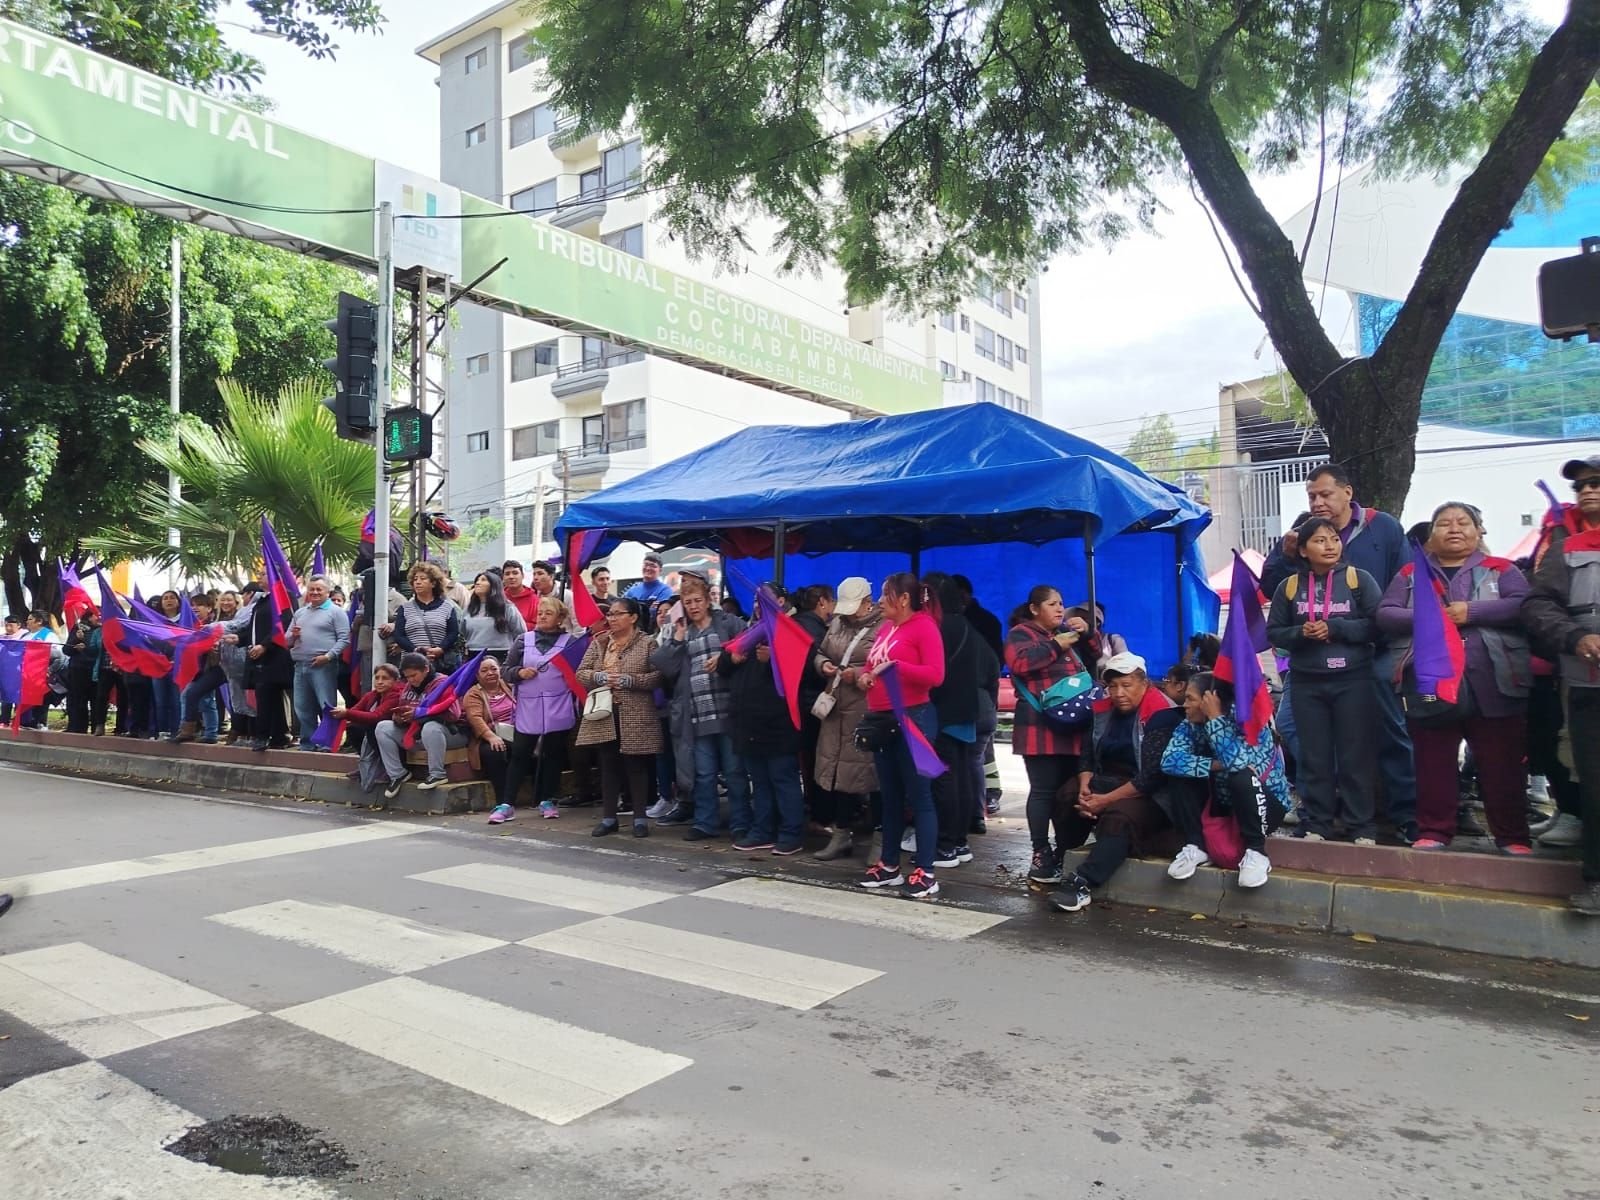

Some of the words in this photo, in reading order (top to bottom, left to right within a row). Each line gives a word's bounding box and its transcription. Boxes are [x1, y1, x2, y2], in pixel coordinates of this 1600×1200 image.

[400, 217, 438, 240] TED
[531, 223, 667, 293] TRIBUNAL
[673, 275, 795, 340] ELECTORAL
[799, 323, 929, 385] DEPARTAMENTAL
[665, 301, 853, 382] COCHABAMBA
[776, 363, 795, 381] EN
